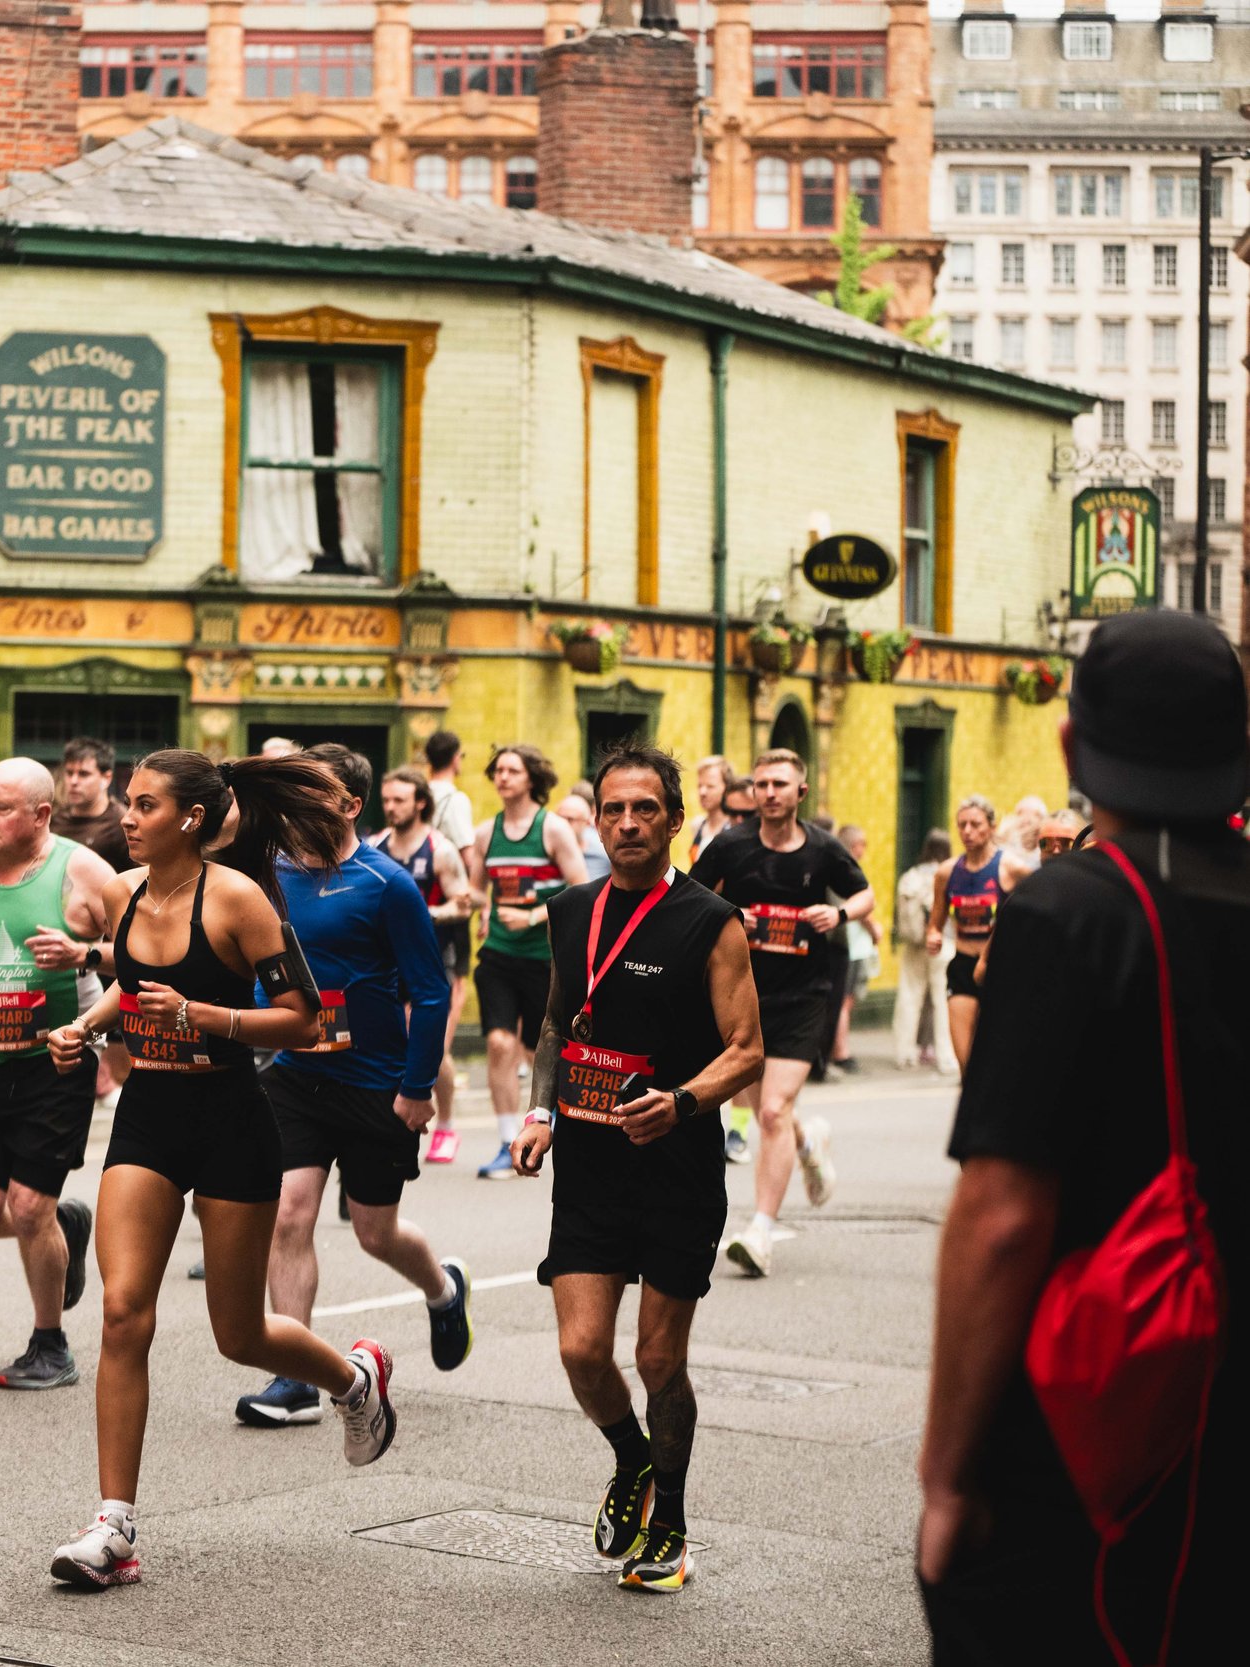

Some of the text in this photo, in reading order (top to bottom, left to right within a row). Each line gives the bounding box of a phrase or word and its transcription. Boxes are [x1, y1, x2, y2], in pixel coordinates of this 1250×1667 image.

[28, 343, 136, 380] WILSONS
[0, 384, 160, 413] PEVERIL OF
[4, 415, 154, 448] THE PEAK
[6, 464, 154, 493] BAR FOOD
[1081, 490, 1149, 514] WILSONS
[3, 513, 155, 542] BAR GAMES
[252, 603, 384, 642] Spirits
[624, 961, 647, 971] TEAM
[647, 965, 663, 974] 247
[142, 1041, 178, 1060] 4545
[589, 1051, 623, 1068] AJBell
[135, 1060, 172, 1070] MANCHESTER
[568, 1066, 628, 1092] STEPHE
[578, 1089, 618, 1110] 3931
[567, 1106, 623, 1125] MANCHESTER 202
